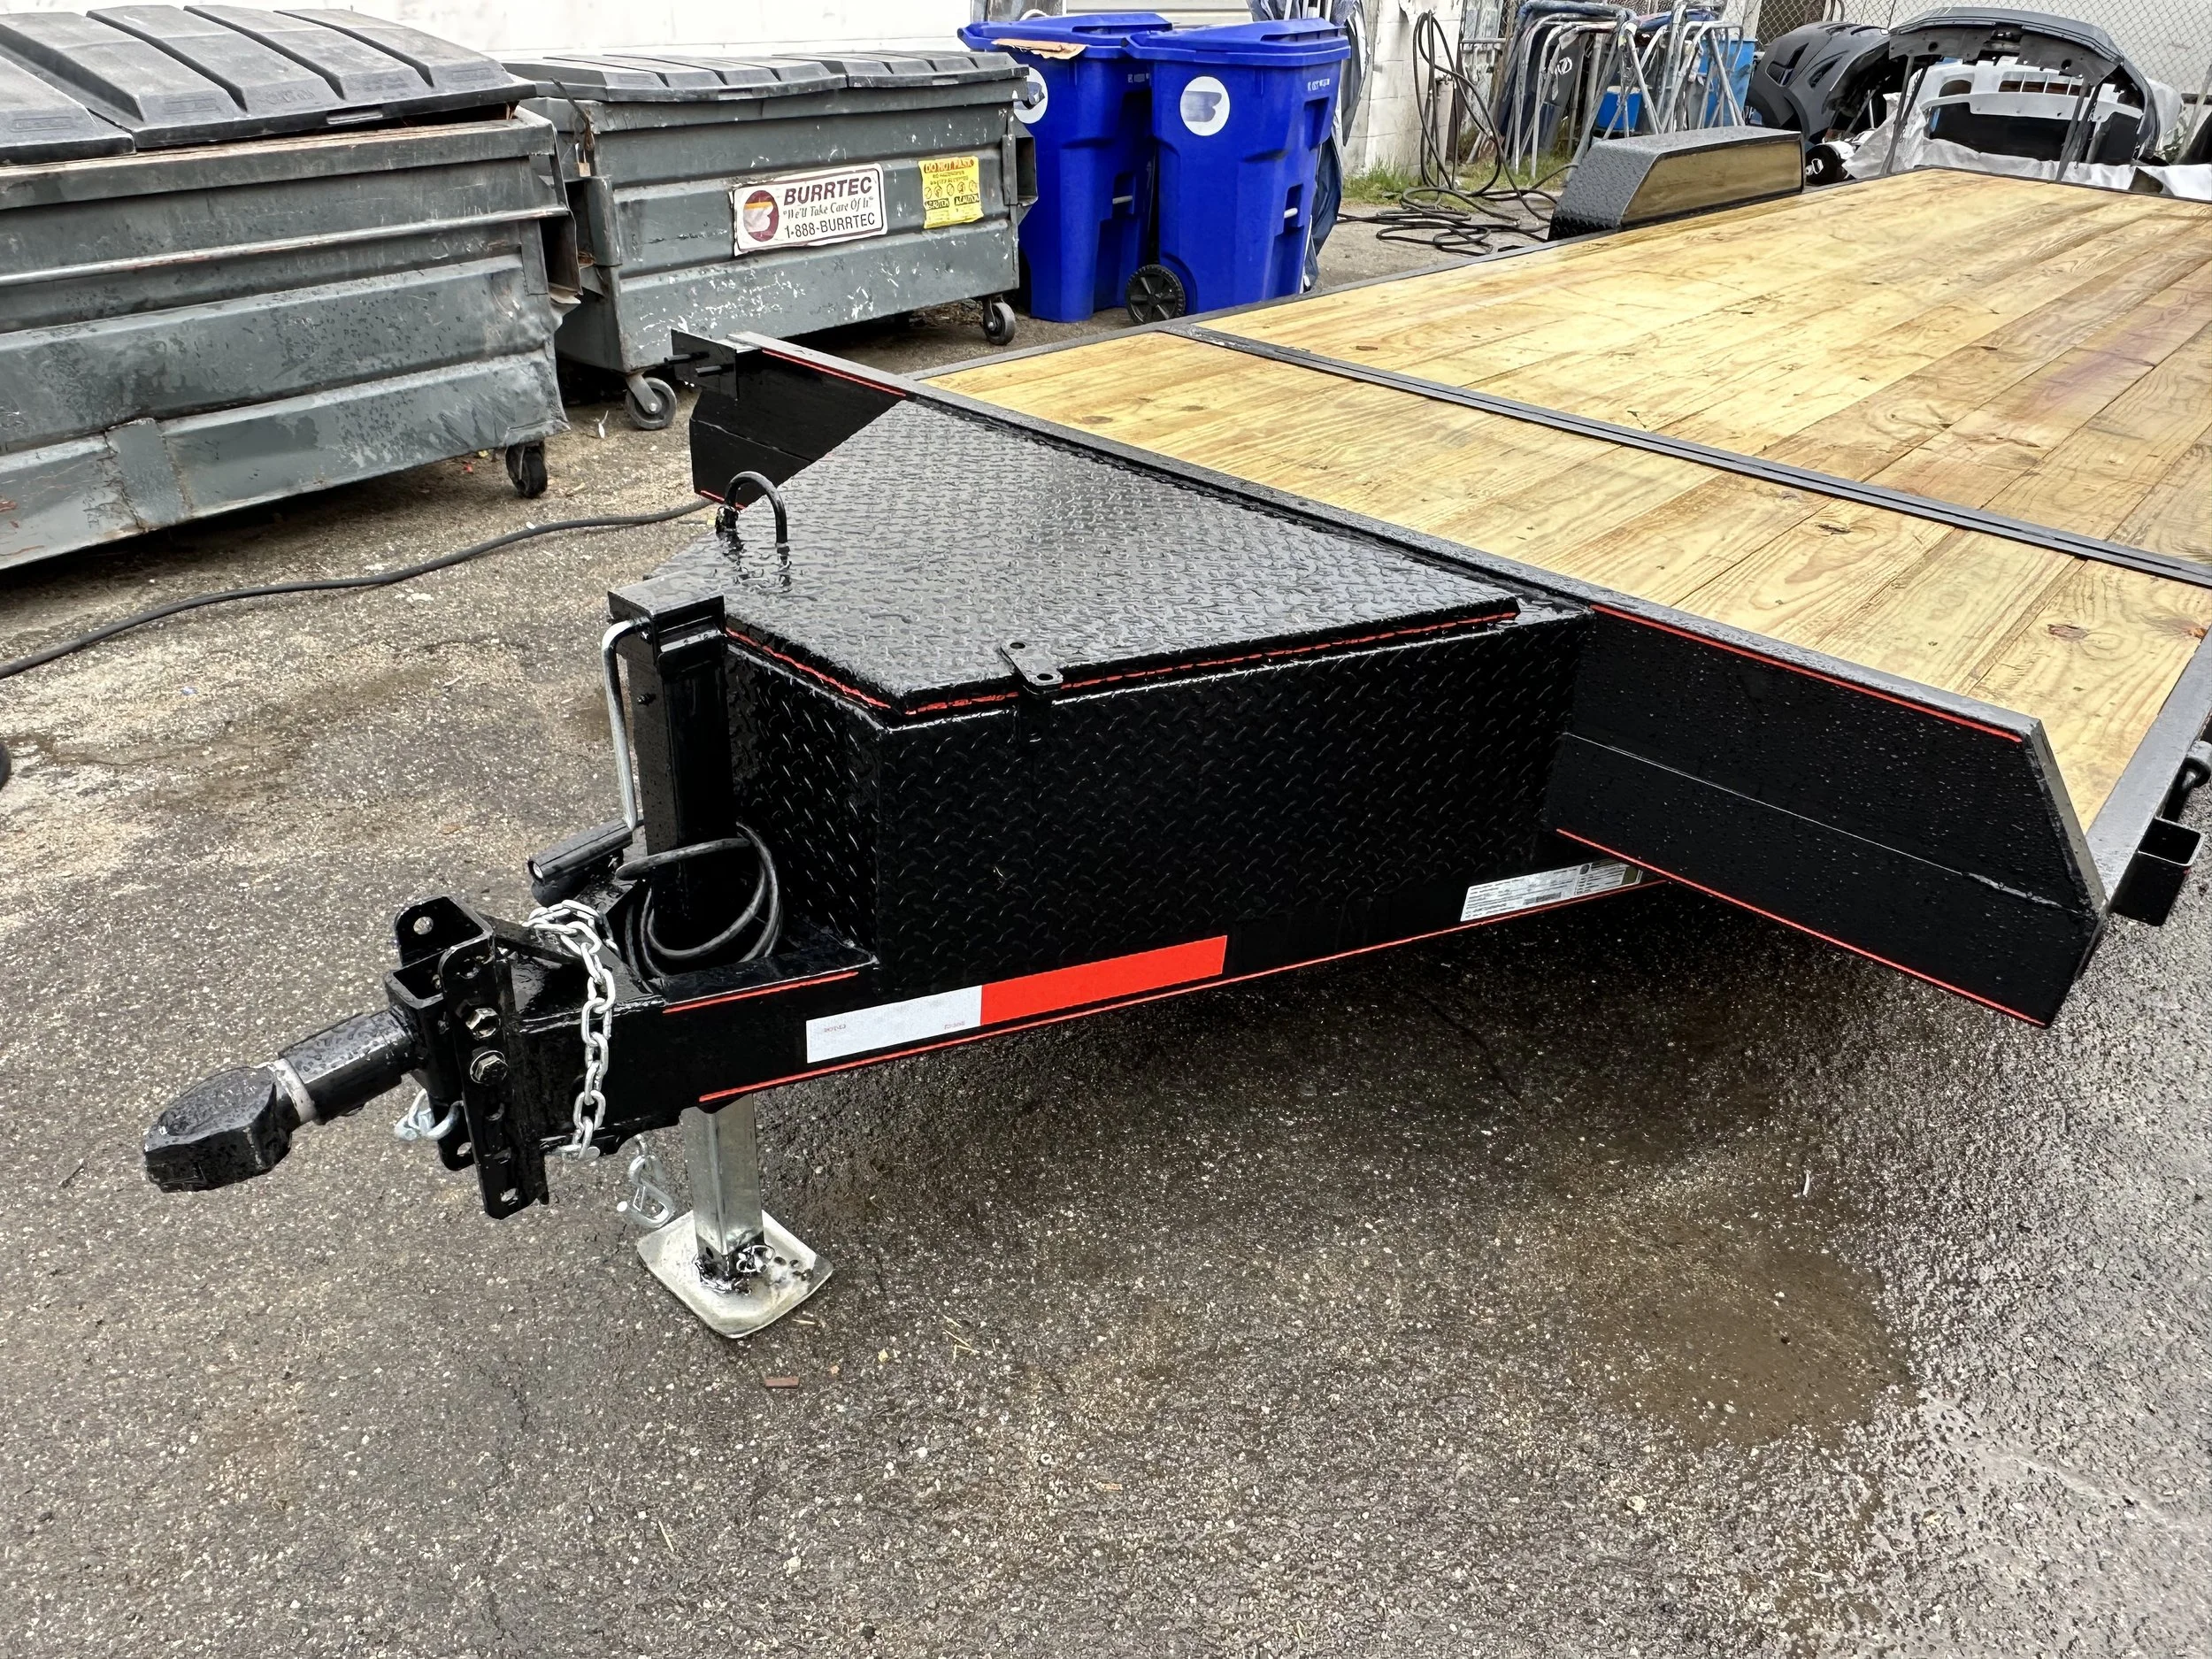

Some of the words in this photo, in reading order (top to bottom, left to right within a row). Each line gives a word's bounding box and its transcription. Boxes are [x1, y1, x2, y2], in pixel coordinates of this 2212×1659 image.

[784, 176, 872, 206] BURRTEC
[810, 204, 828, 217] Take
[830, 202, 849, 213] Care
[850, 197, 861, 212] Of
[784, 211, 875, 239] 1-888-BURRTEC
